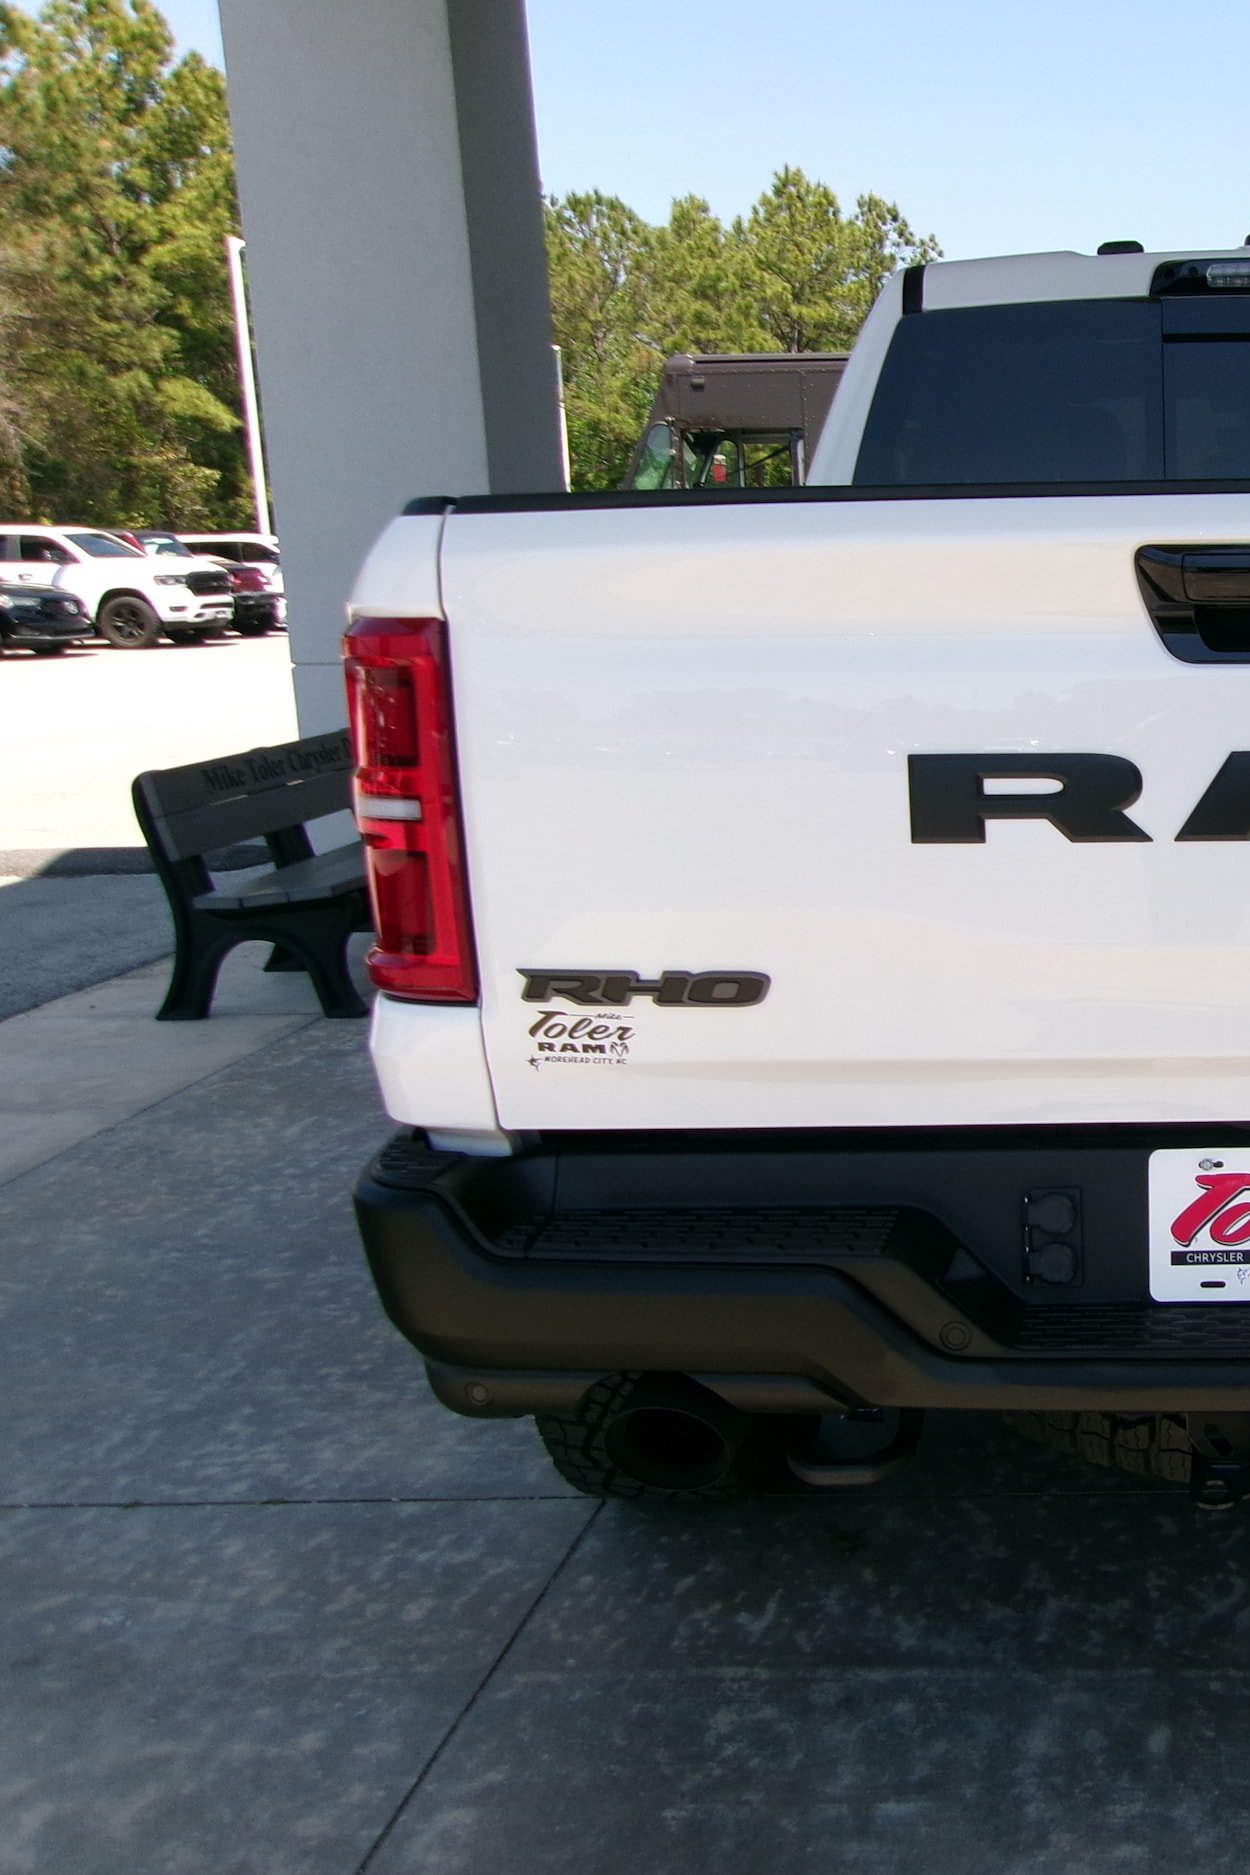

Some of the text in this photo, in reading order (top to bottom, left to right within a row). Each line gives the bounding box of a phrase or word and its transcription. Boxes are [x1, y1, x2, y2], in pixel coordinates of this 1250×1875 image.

[201, 765, 246, 795] Mike
[246, 756, 286, 783] Toler
[516, 968, 771, 1007] RHO
[528, 1010, 636, 1041] Toler
[537, 1041, 606, 1054] RAM
[544, 1056, 591, 1064] MOREHEAD
[1186, 1252, 1244, 1263] CHRYSLER
